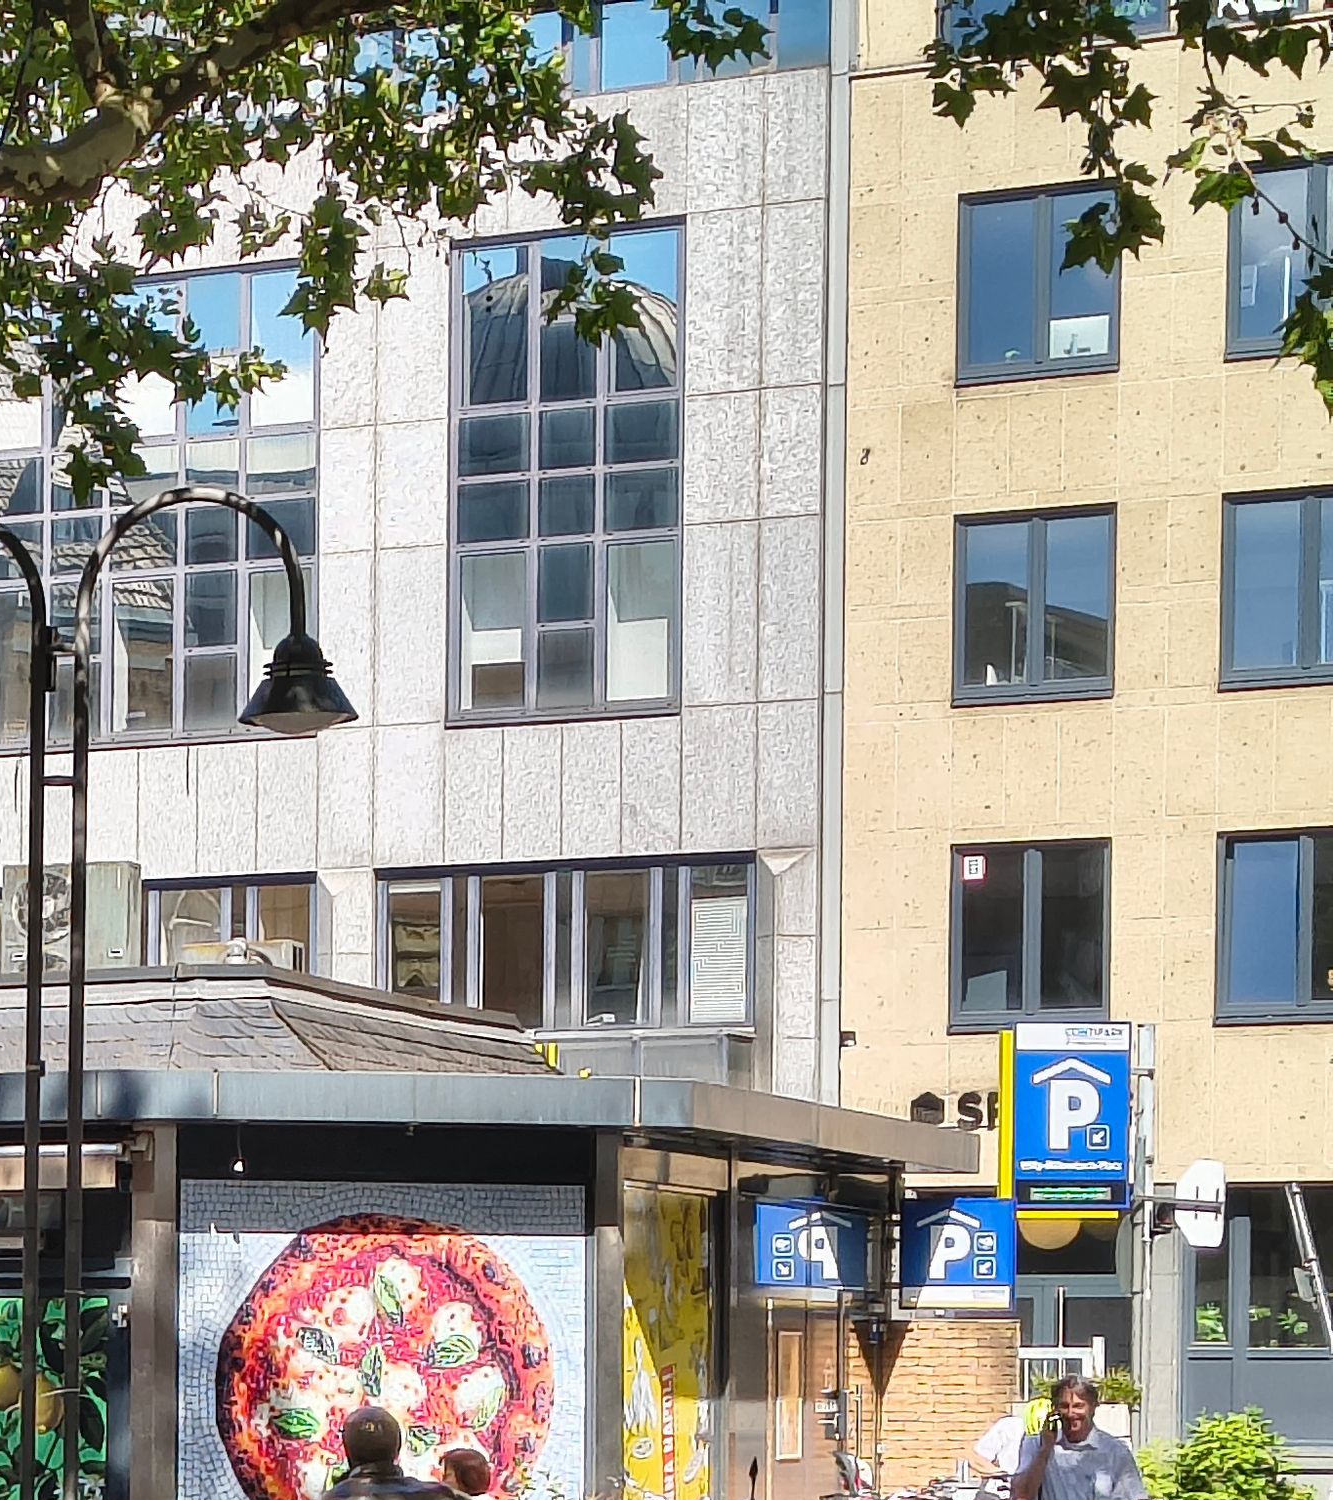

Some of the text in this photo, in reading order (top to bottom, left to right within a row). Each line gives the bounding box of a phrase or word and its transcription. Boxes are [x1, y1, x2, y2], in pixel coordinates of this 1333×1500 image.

[1049, 1079, 1101, 1151] P
[929, 1223, 972, 1281] P
[662, 1371, 675, 1454] NAPOLI
